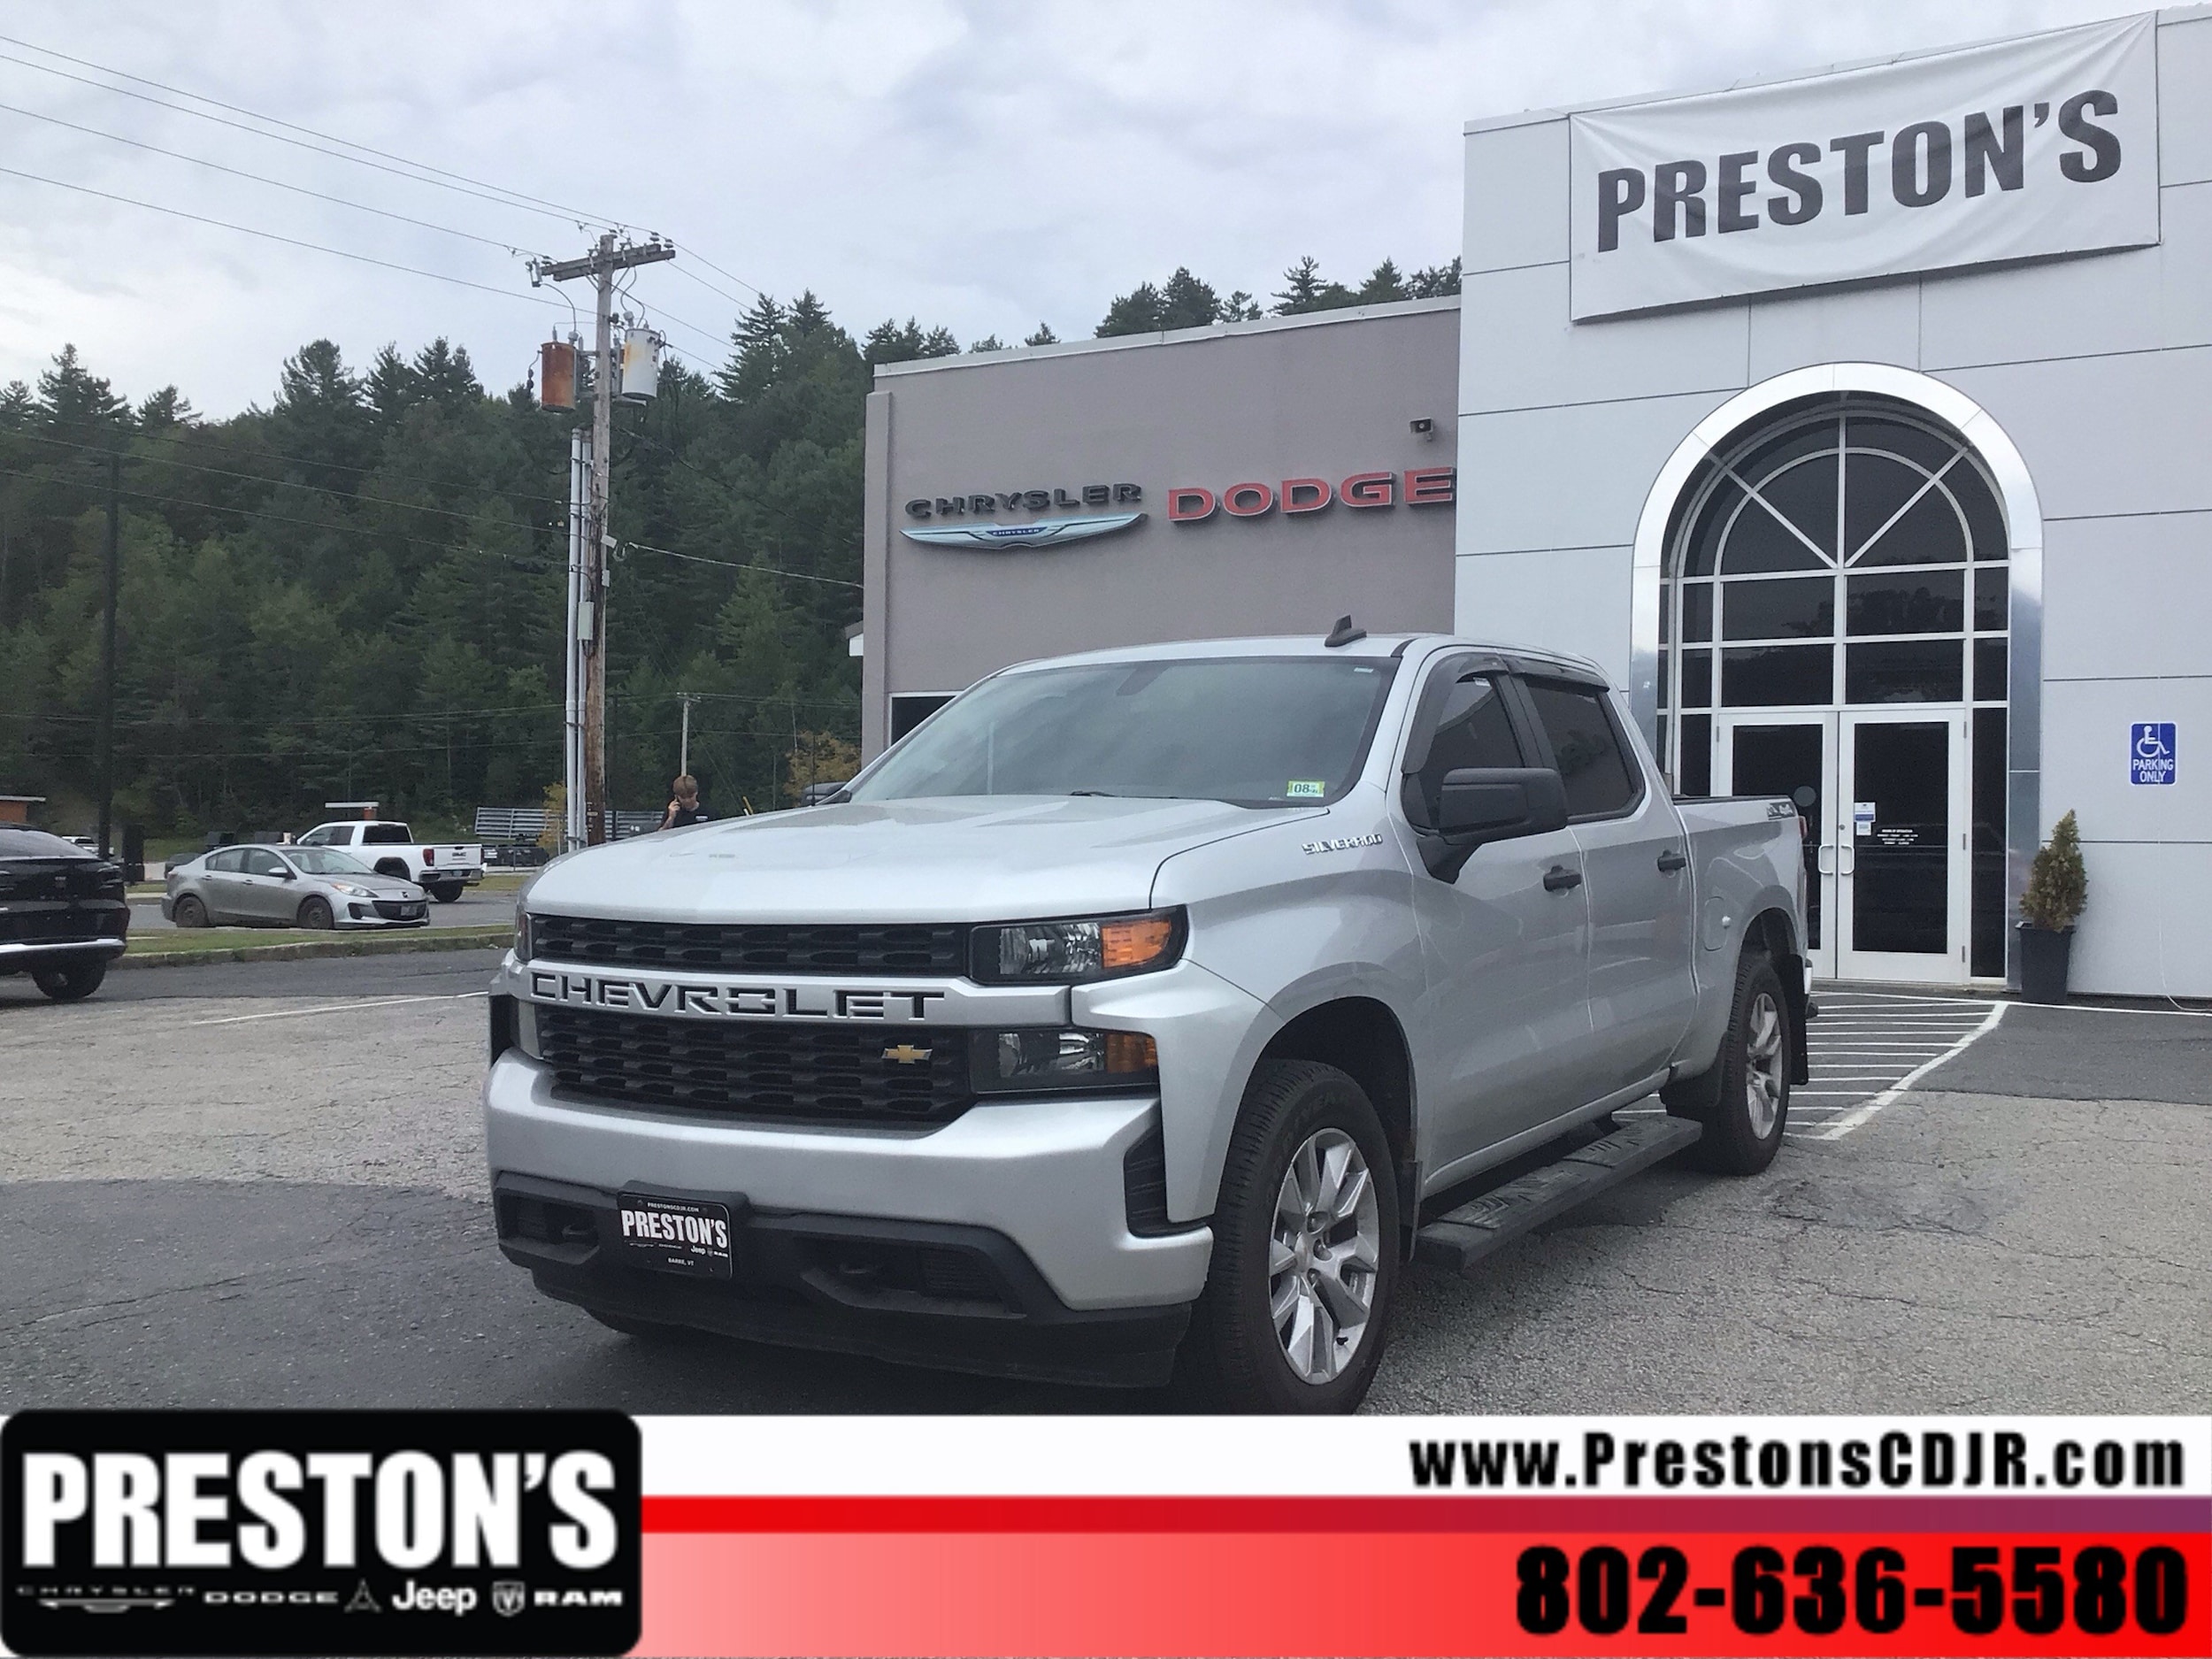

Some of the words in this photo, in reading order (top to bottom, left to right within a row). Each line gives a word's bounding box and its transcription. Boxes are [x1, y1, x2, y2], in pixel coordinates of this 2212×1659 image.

[1598, 89, 2121, 253] PRESTON'S
[904, 483, 1142, 518] CHRYSLER
[1168, 466, 1456, 522] DODGE
[2132, 758, 2174, 771] PARKING
[2139, 771, 2166, 782] ONLY
[1294, 784, 1310, 793] 08
[530, 973, 945, 1021] CHEVROLET
[621, 1210, 728, 1248] PRESTON'S
